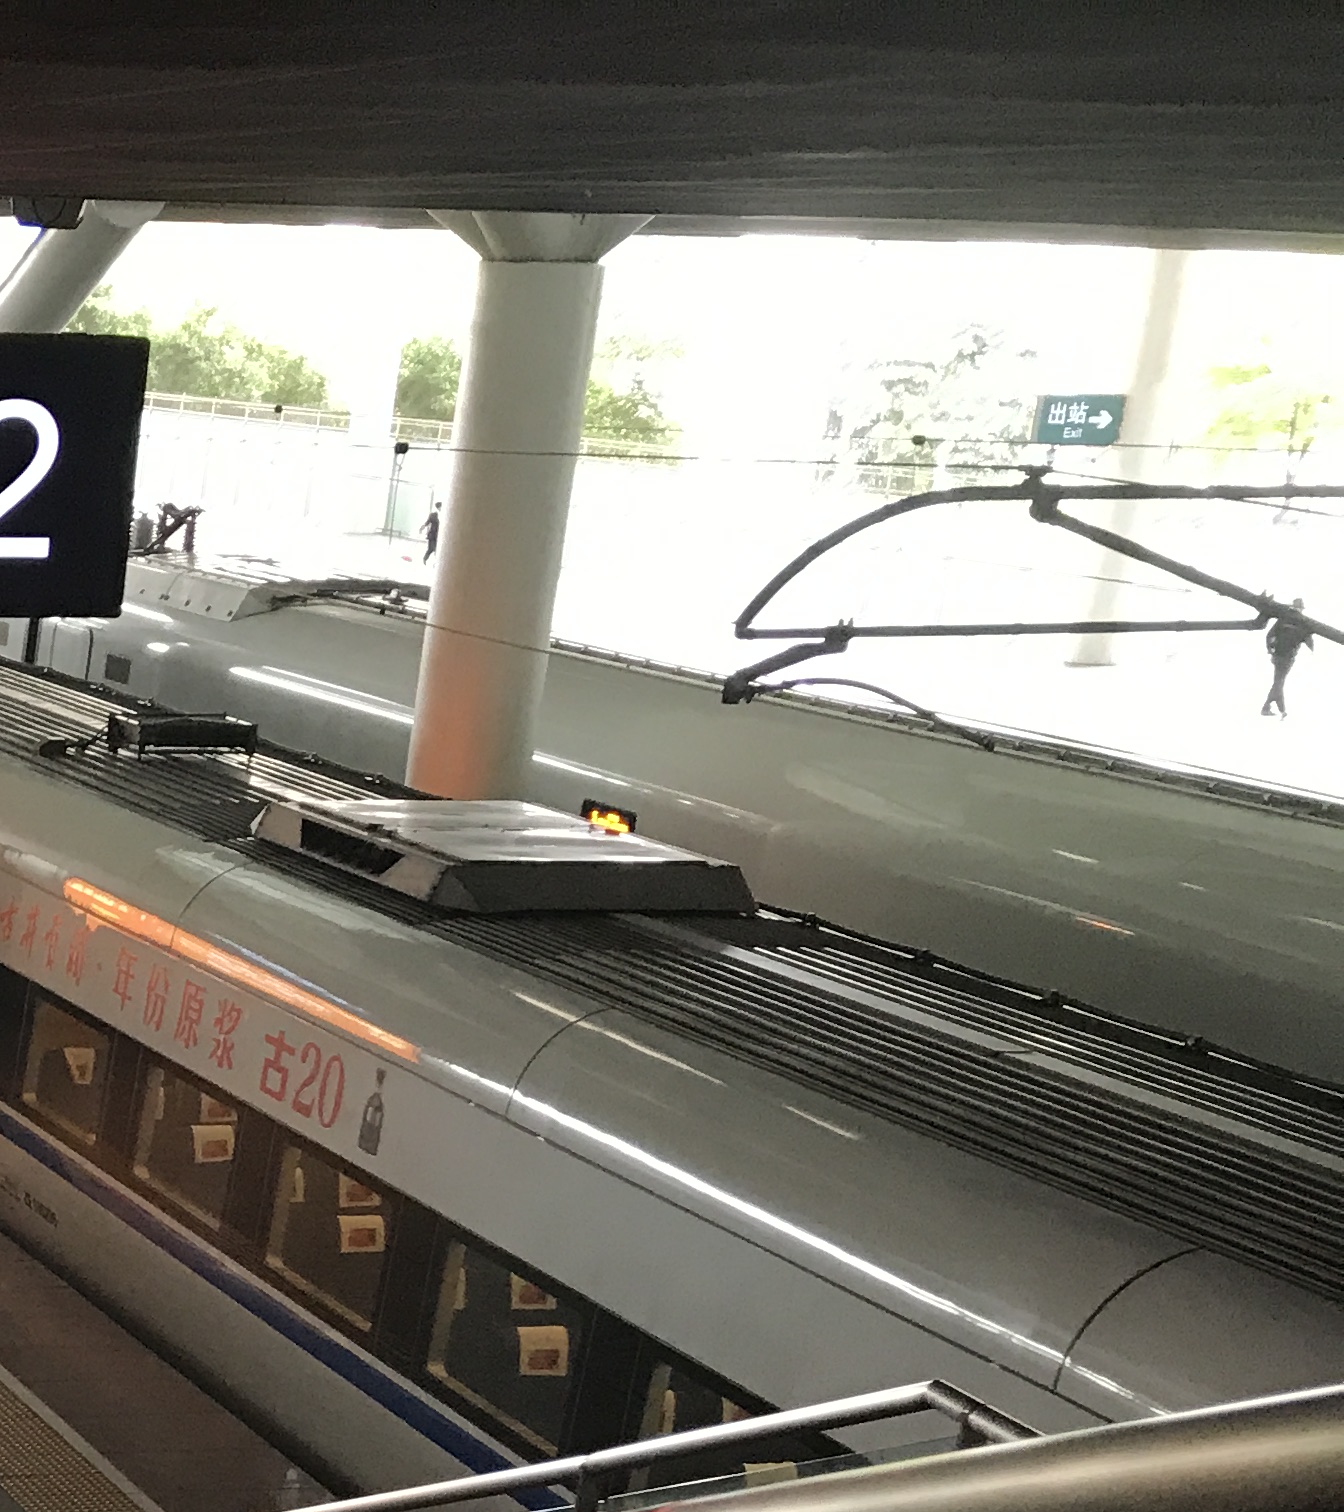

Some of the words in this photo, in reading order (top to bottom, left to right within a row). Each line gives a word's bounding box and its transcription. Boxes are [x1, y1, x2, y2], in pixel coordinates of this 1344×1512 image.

[1047, 401, 1090, 425] 出站
[1062, 426, 1083, 438] Exit
[259, 1029, 347, 1129] 古20
